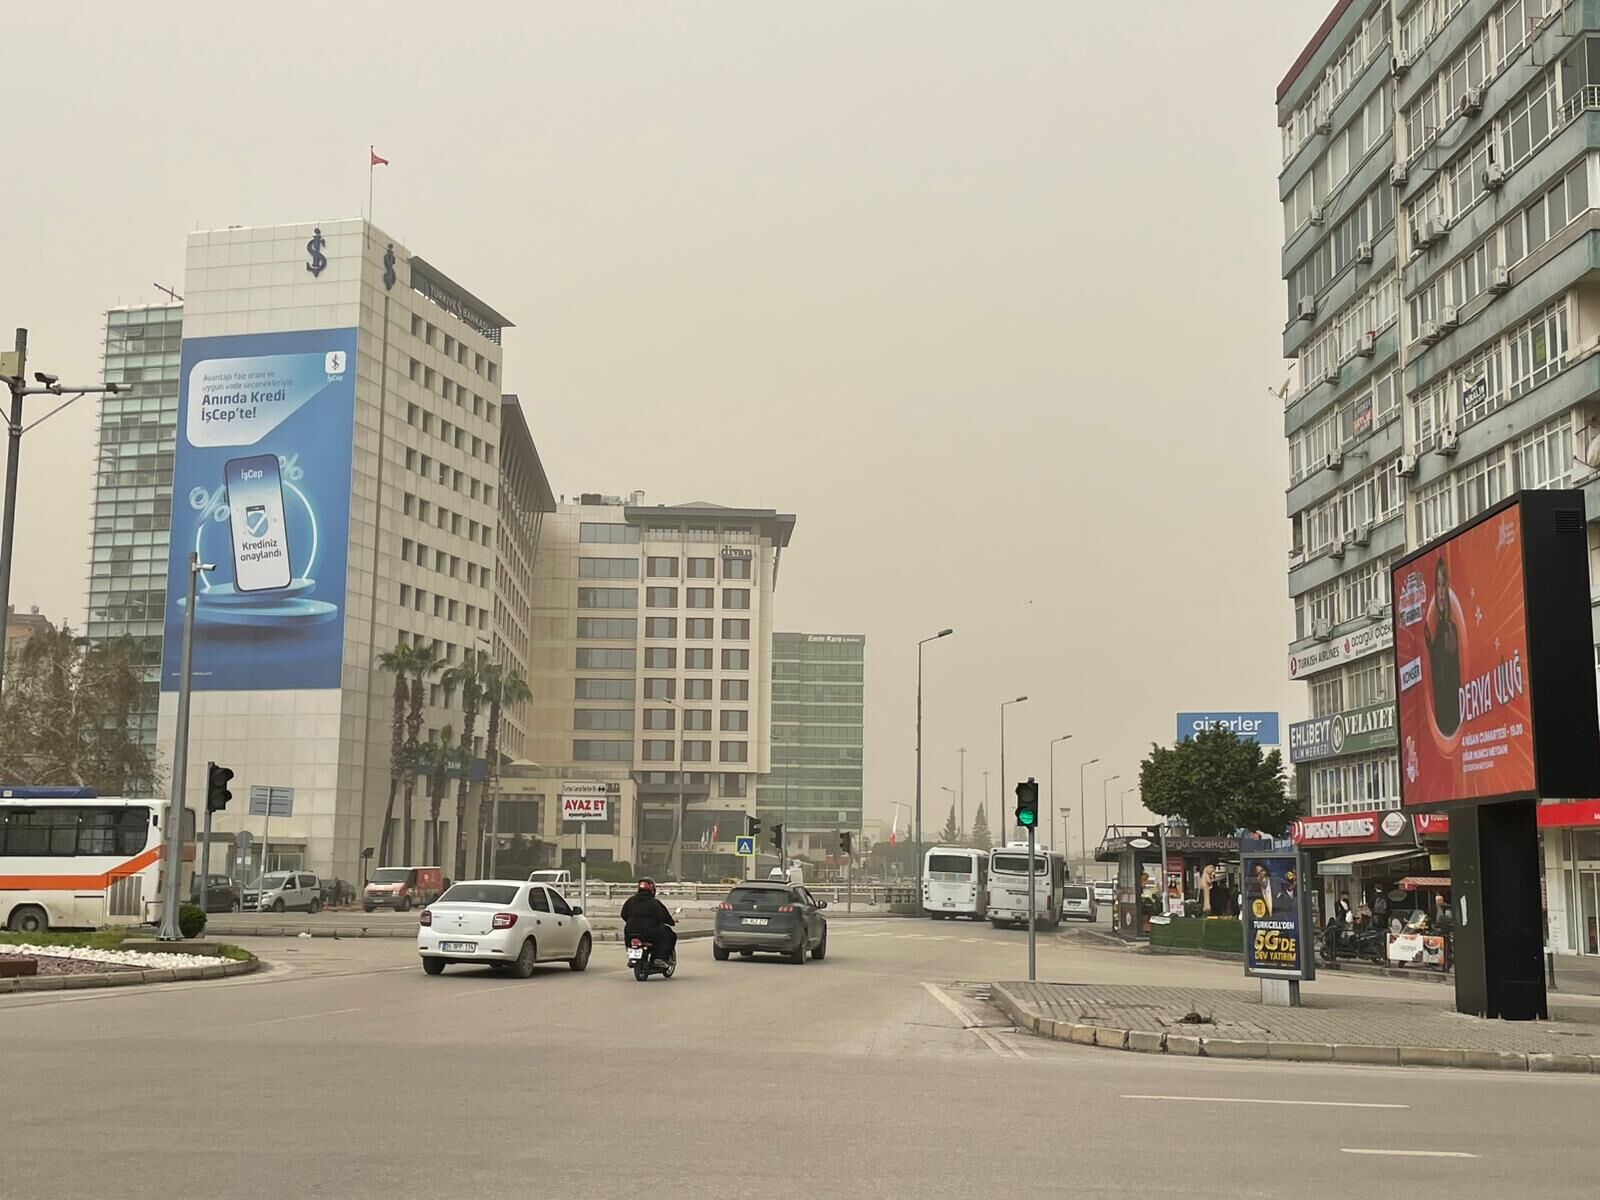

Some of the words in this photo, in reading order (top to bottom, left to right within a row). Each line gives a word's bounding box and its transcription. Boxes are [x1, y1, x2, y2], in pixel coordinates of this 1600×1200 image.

[203, 373, 232, 382] Avantajlı
[234, 372, 246, 380] faiz
[202, 383, 224, 392] uygun
[226, 382, 242, 390] vade
[202, 391, 247, 405] Anında
[250, 389, 286, 403] Kredi
[201, 407, 257, 424] İşCep'te!
[241, 468, 263, 481] İşCep
[242, 538, 278, 551] Krediniz
[721, 545, 752, 556] divan
[240, 549, 282, 562] onaylandı
[1297, 653, 1318, 670] TURKISH
[1319, 646, 1340, 662] AIRLINES
[1458, 672, 1492, 721] DERYA
[1493, 649, 1523, 705] ULUĞ
[1344, 706, 1396, 737] VELAYET
[564, 799, 592, 811] AYAZ
[593, 799, 606, 811] ET
[1253, 920, 1295, 930] TURKCELL'DEN
[1253, 930, 1296, 952] 5G'DE
[1254, 951, 1269, 961] DEV
[1270, 951, 1297, 962] YATIRIM
